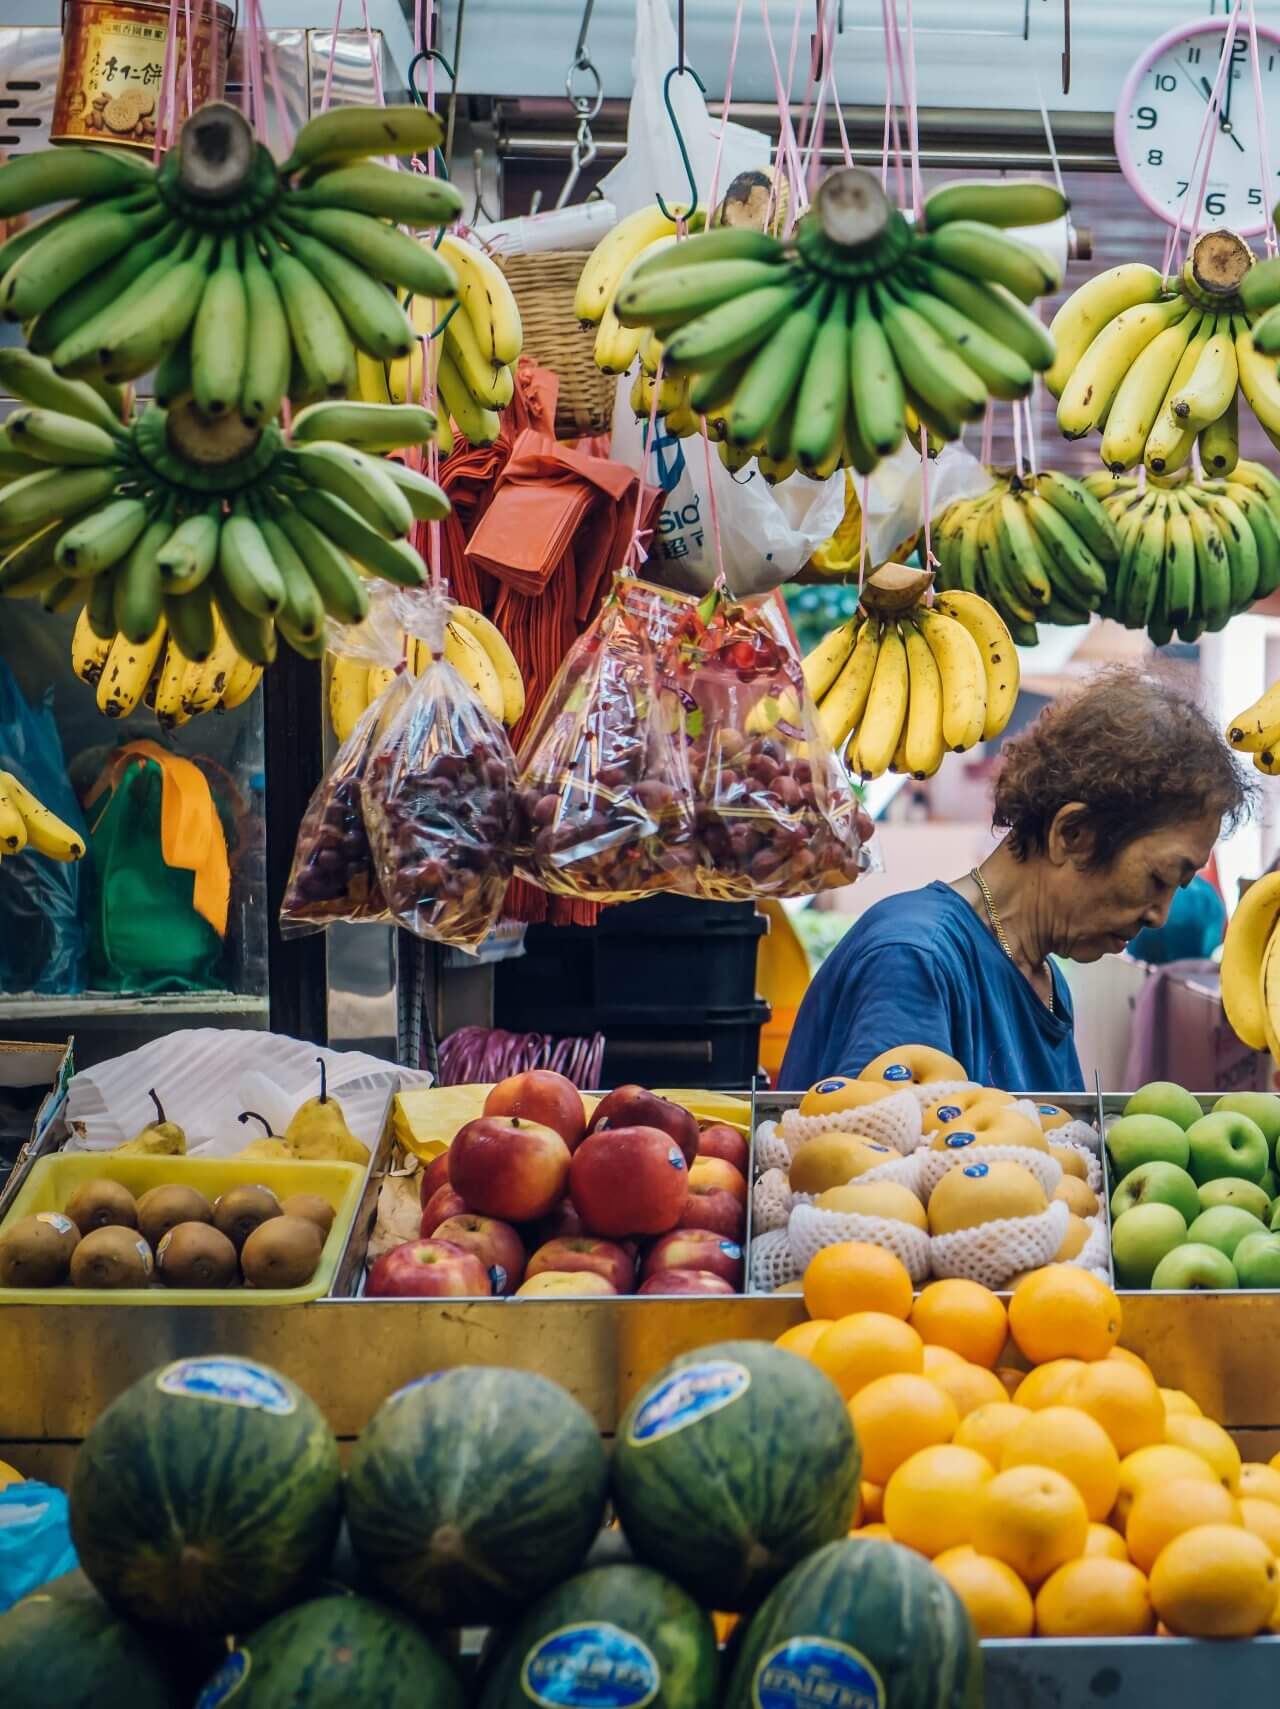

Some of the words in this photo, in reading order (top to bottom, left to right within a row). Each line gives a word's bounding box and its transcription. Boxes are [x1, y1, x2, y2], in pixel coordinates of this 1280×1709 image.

[1187, 47, 1201, 65] 11
[1268, 55, 1275, 73] 1
[1155, 73, 1177, 93] 10
[1136, 106, 1158, 130] 9
[1147, 149, 1163, 166] 8
[1176, 181, 1190, 198] 7
[1247, 188, 1263, 205] 5
[1205, 192, 1226, 216] 6
